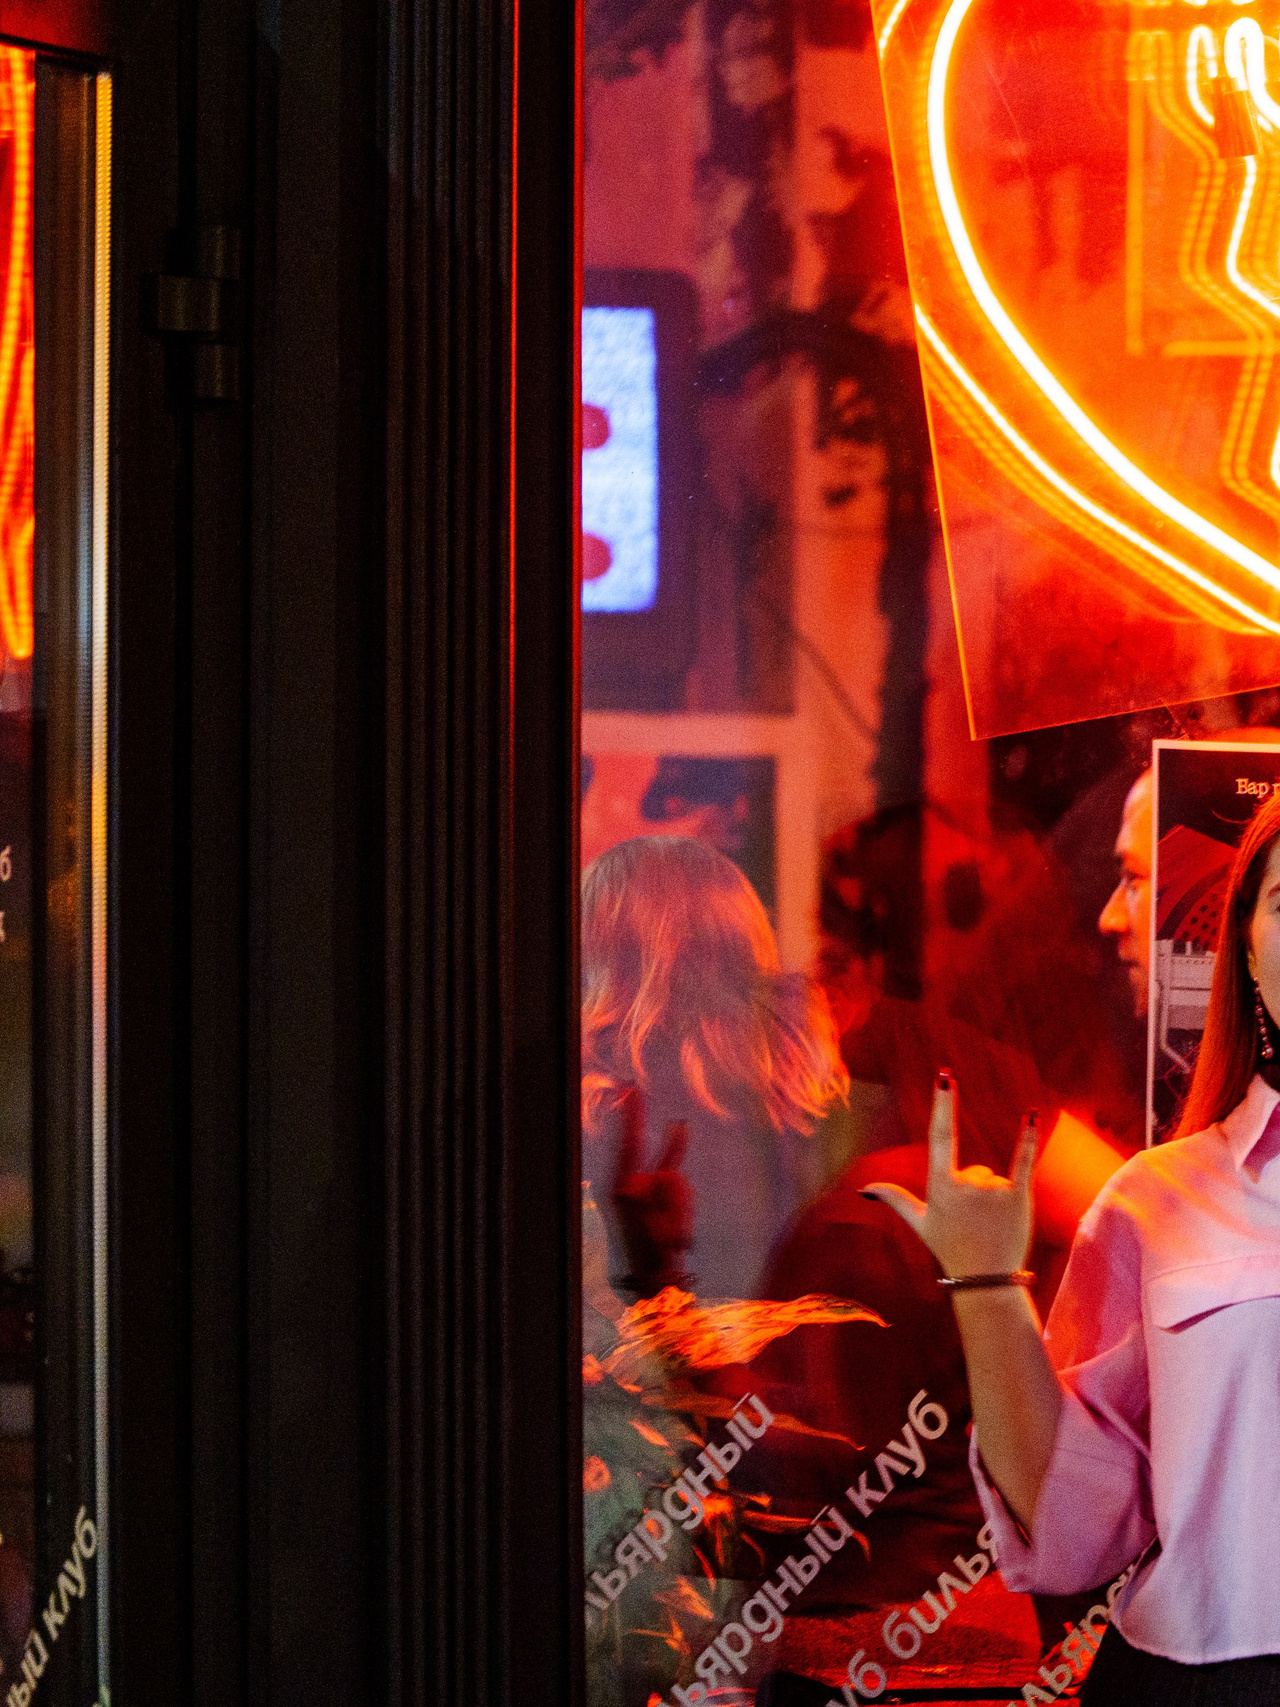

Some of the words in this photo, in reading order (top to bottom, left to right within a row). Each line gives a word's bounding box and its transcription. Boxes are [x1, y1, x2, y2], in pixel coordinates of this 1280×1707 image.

[1235, 777, 1270, 799] Бар
[42, 1505, 98, 1642] клуб
[654, 1504, 854, 1707] ьярдный
[845, 1389, 949, 1518] клуб
[882, 1521, 999, 1659] билья
